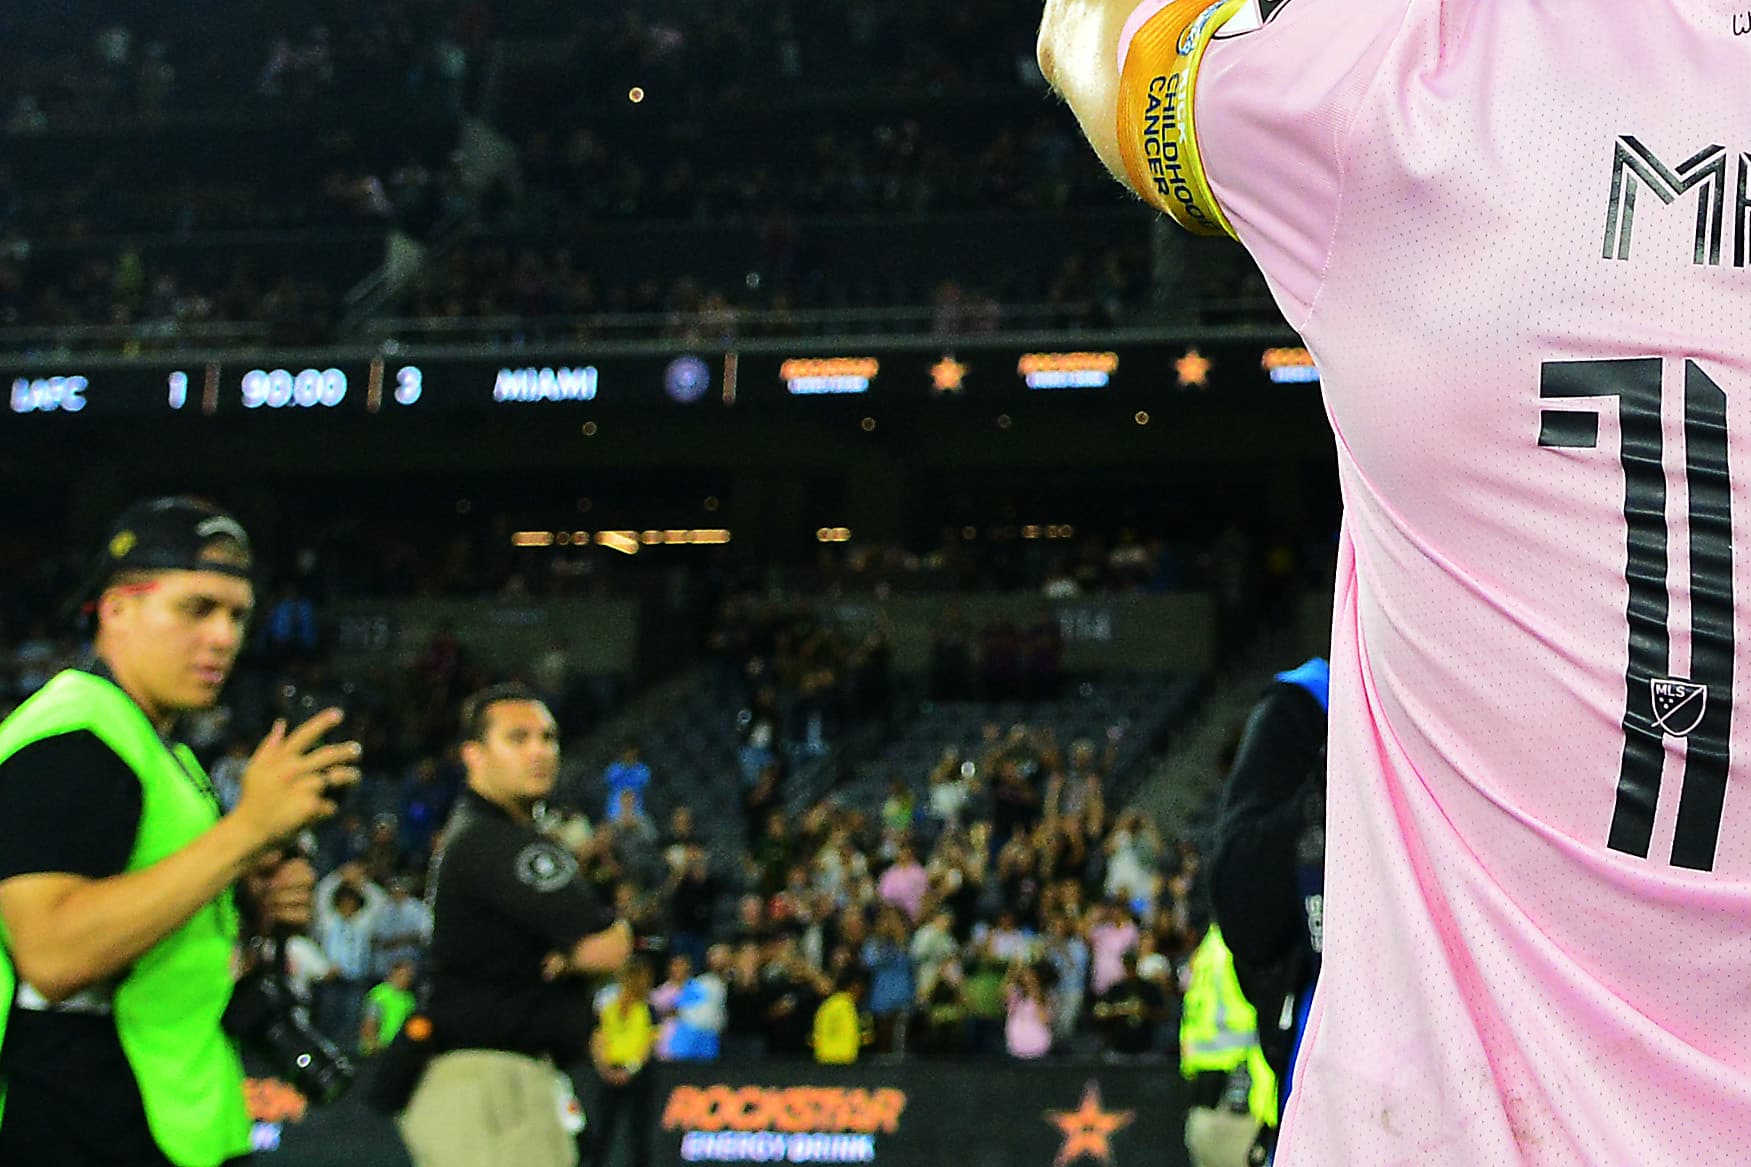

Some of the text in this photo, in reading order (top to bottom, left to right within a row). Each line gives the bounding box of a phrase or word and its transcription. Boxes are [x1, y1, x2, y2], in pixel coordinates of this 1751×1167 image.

[1143, 75, 1170, 196] CANCER
[168, 370, 189, 410] 1
[394, 365, 423, 405] 3
[493, 365, 599, 402] MIAMI
[1655, 684, 1686, 698] MLS
[661, 1083, 908, 1135] ROCKSTAR
